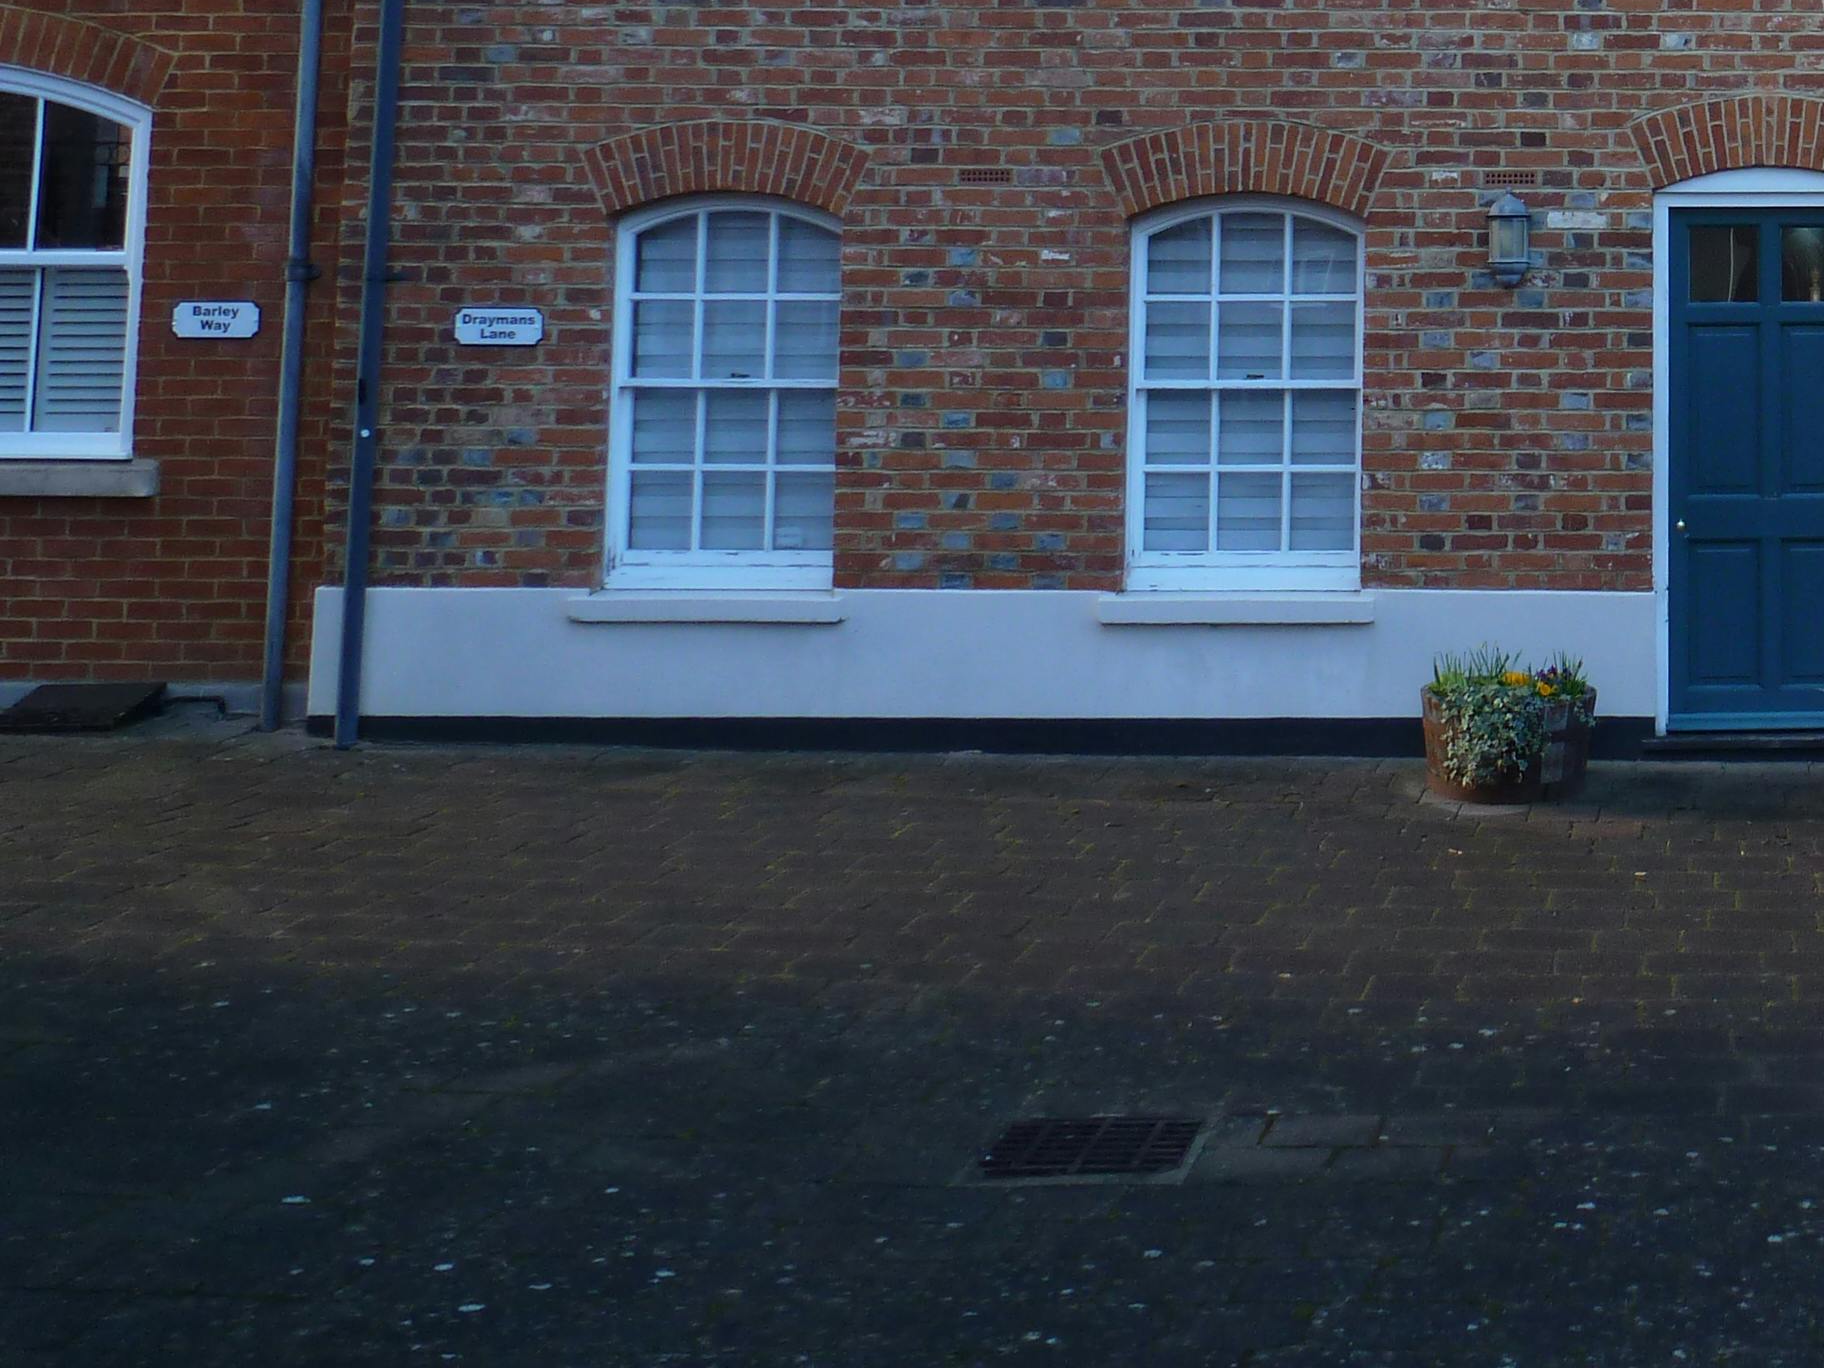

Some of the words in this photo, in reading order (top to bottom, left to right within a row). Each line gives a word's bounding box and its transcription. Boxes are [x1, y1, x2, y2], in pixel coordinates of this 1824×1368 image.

[192, 306, 239, 319] Barley
[200, 320, 231, 333] Way
[462, 314, 536, 327] Draymans
[480, 329, 516, 339] Lane
